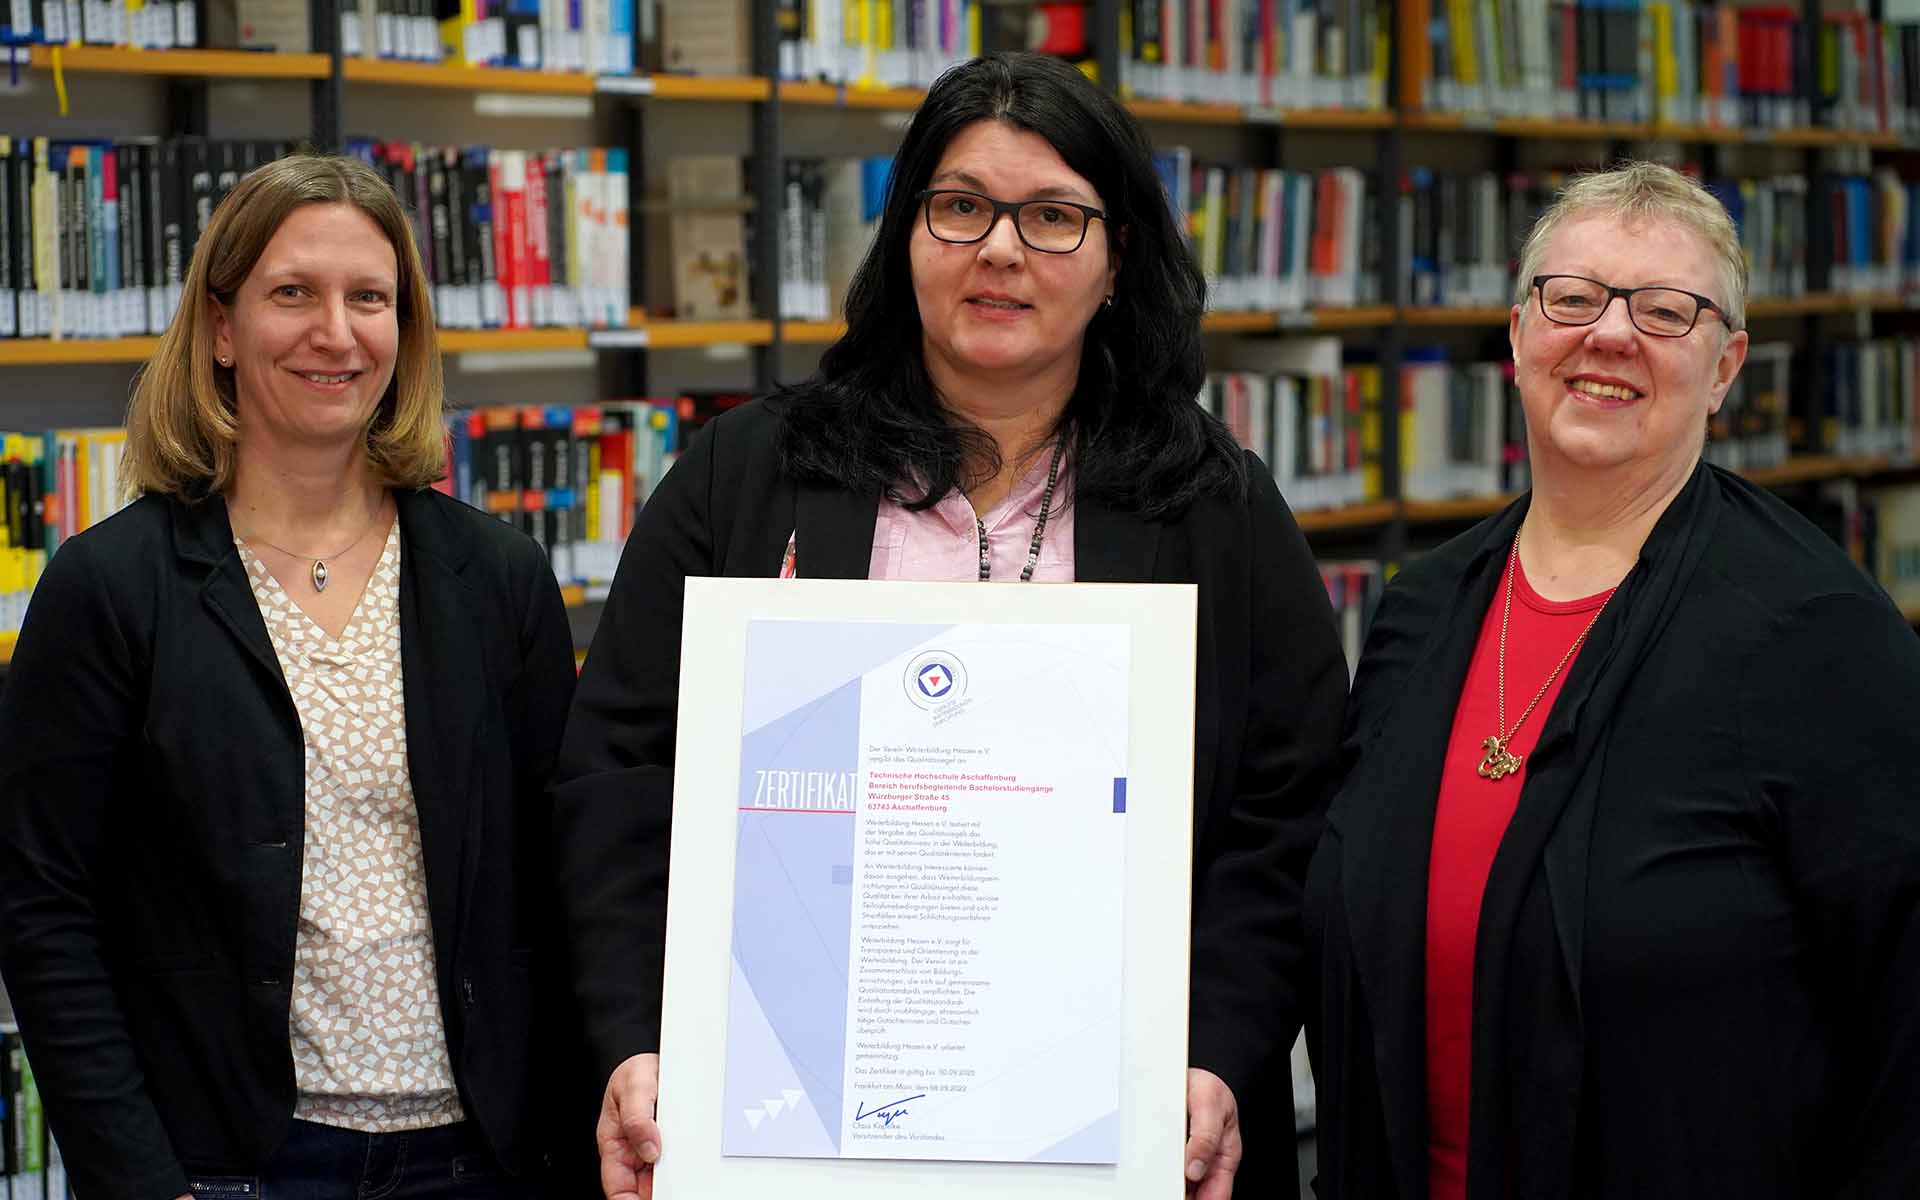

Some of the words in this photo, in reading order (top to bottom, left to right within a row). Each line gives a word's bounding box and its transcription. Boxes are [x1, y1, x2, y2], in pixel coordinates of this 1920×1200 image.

[961, 773, 1017, 782] Aschaffenburg
[754, 769, 858, 809] ZERTIFIKAT
[900, 782, 967, 791] berufsbegleitende
[969, 784, 1054, 793] Bachelorstudiengänge
[868, 793, 912, 801] Würzburger
[891, 803, 948, 812] Aschaffenburg
